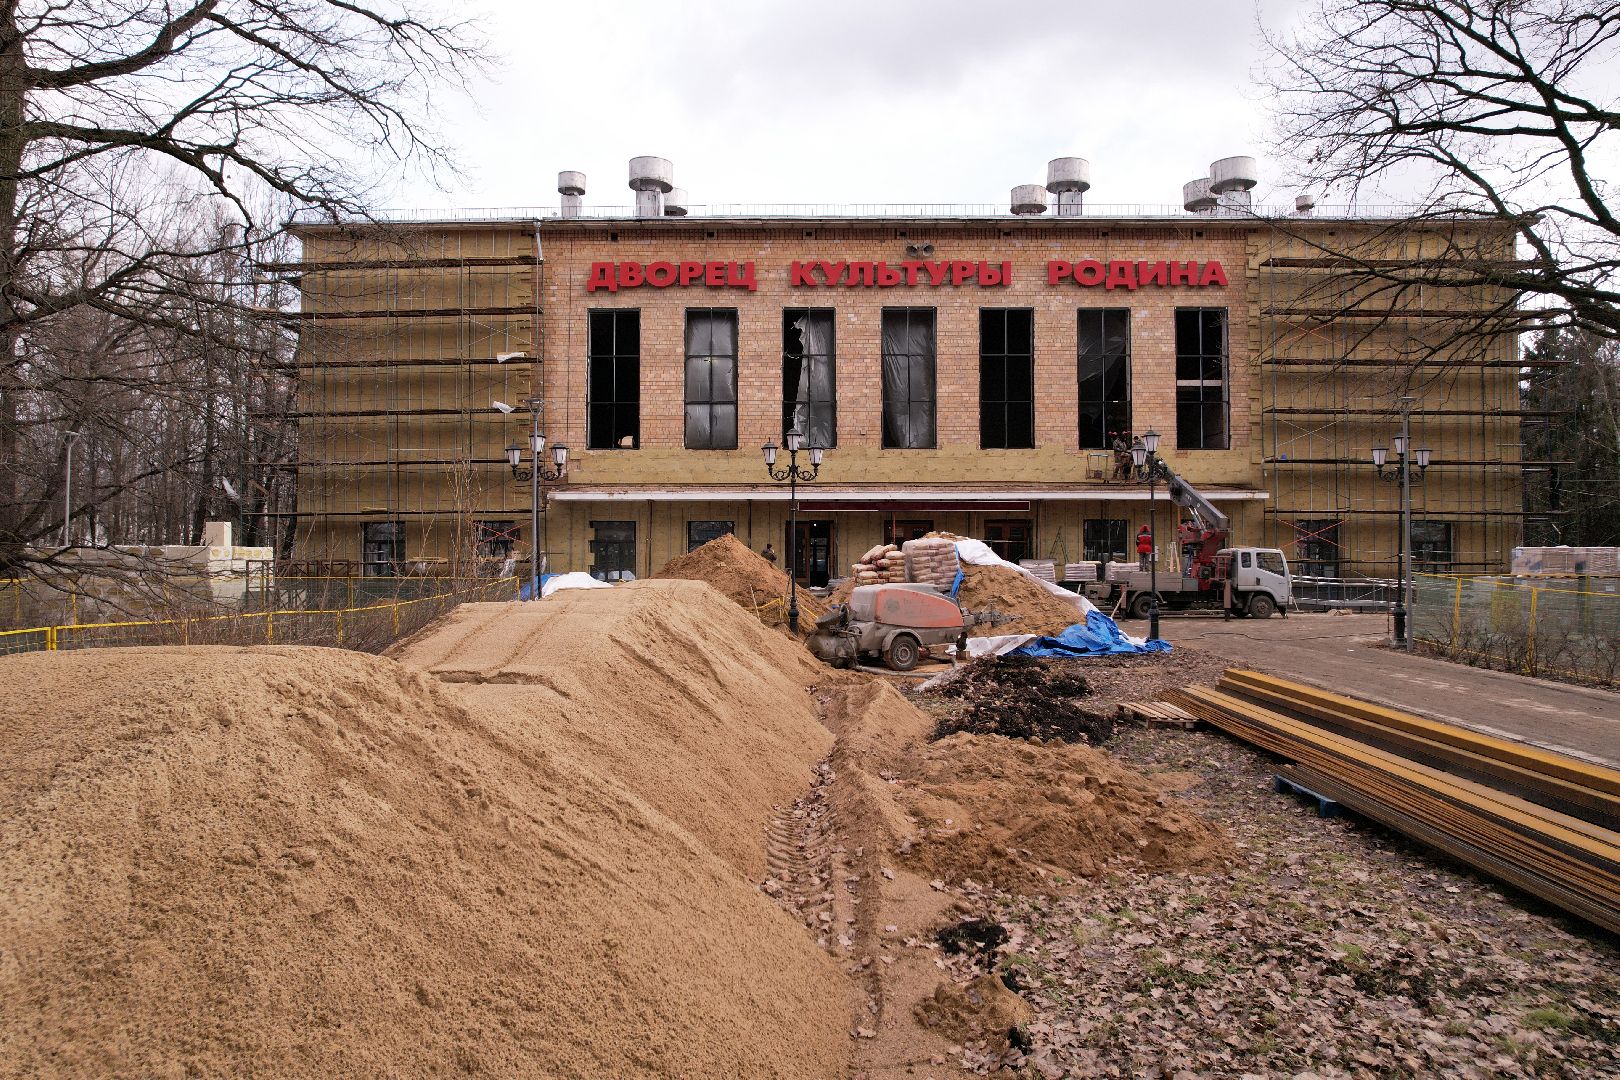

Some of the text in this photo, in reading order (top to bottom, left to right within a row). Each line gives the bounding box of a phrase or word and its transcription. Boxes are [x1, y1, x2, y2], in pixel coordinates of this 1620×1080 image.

[586, 257, 1228, 291] ДВОРЕЦ КУЛЬТУРЫ РОДИНА
